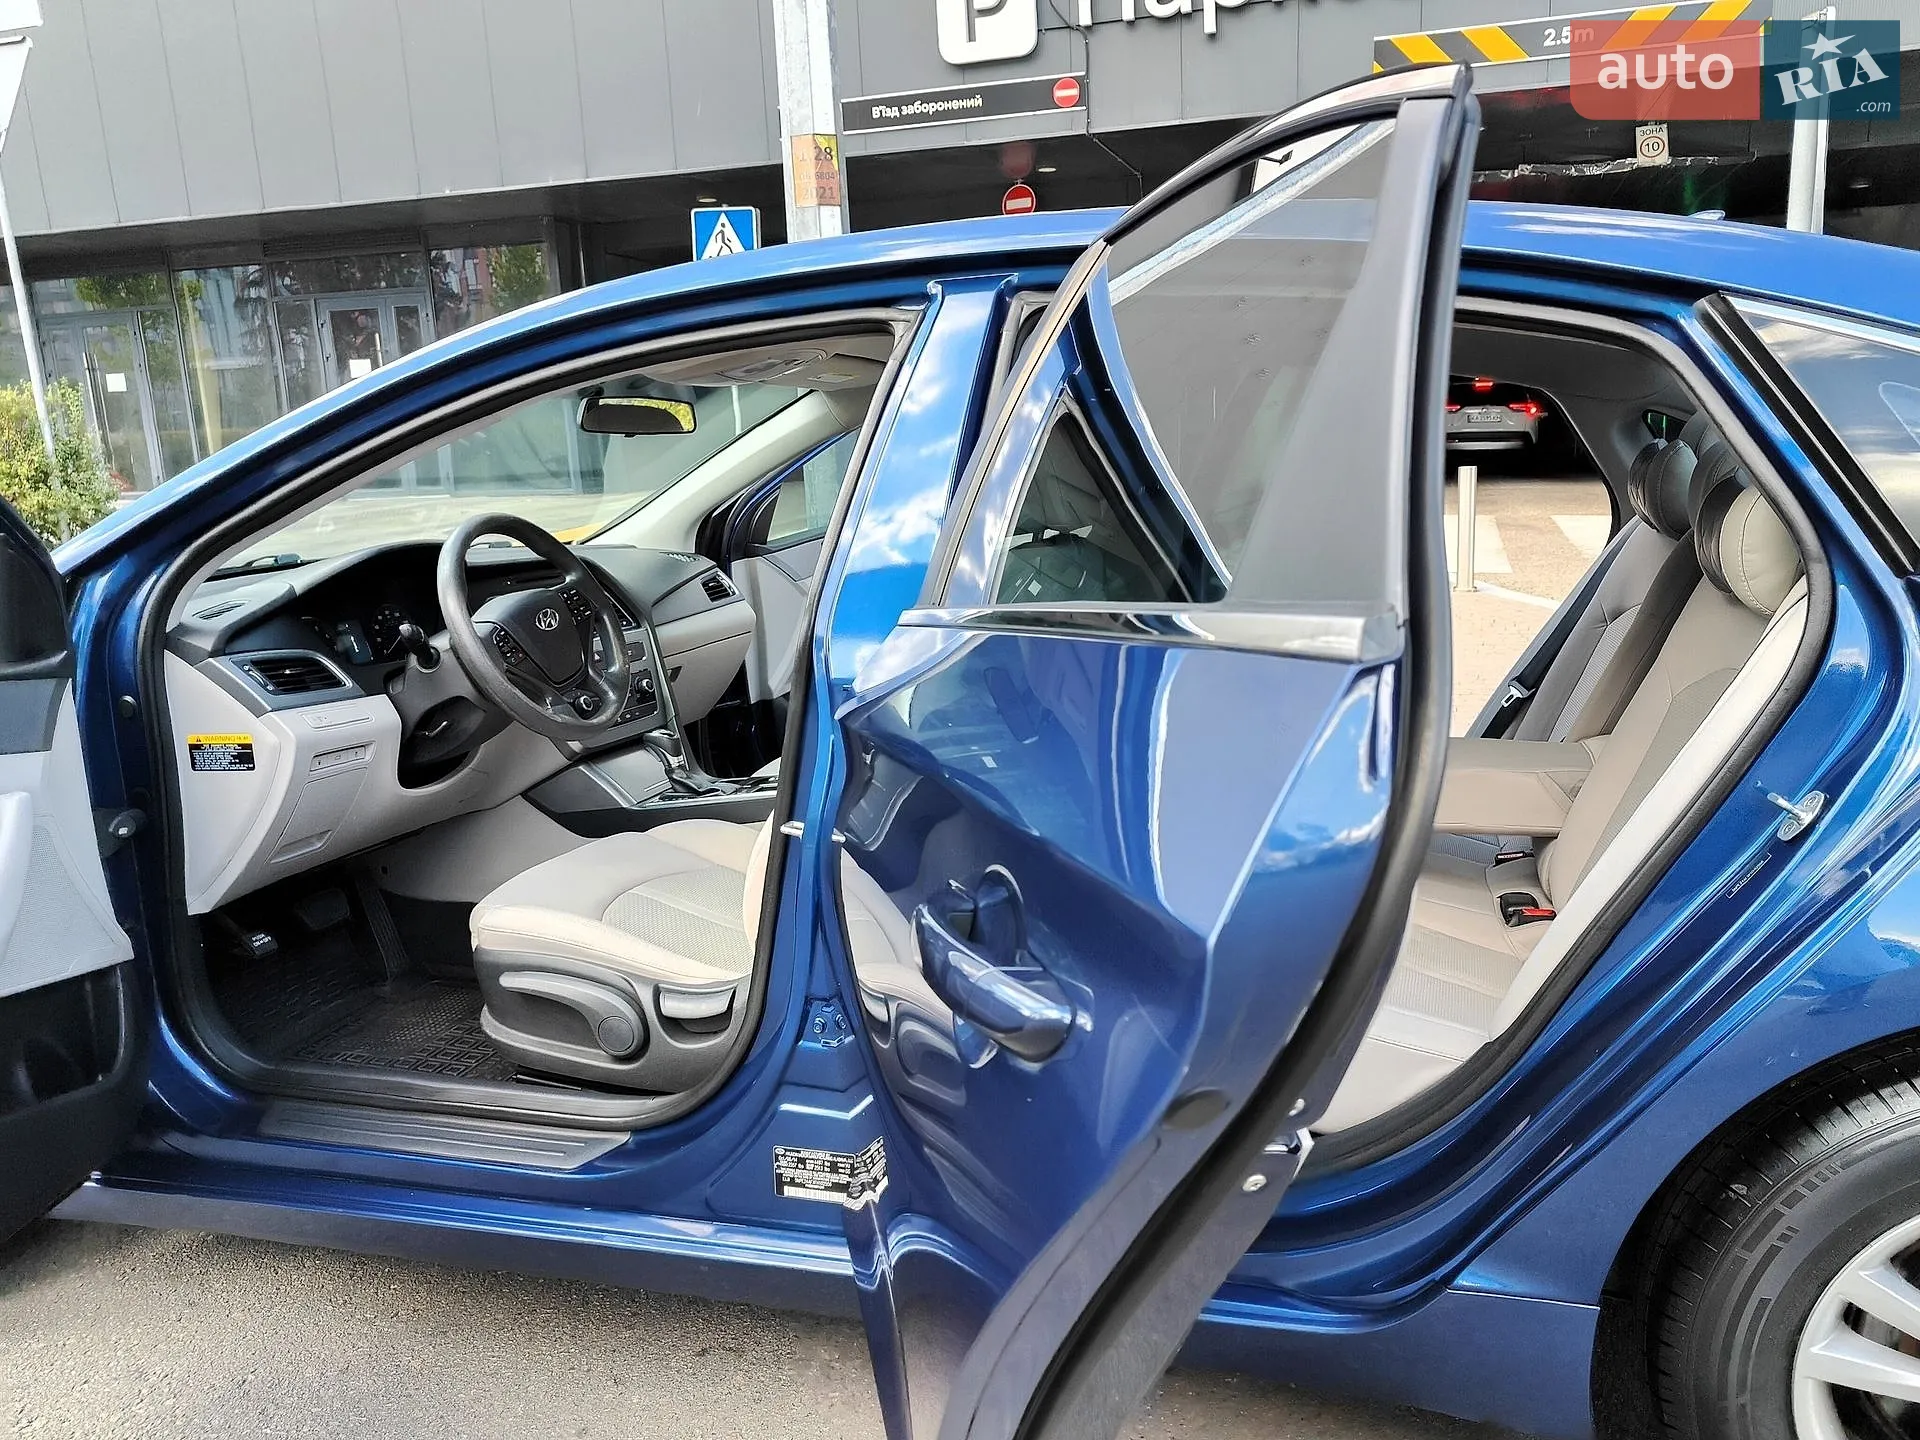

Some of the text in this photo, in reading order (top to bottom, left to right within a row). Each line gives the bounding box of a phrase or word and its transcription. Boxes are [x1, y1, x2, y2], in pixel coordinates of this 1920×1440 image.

[901, 94, 983, 115] заборонений
[1640, 126, 1664, 136] ЗОНА
[1645, 142, 1660, 152] 10
